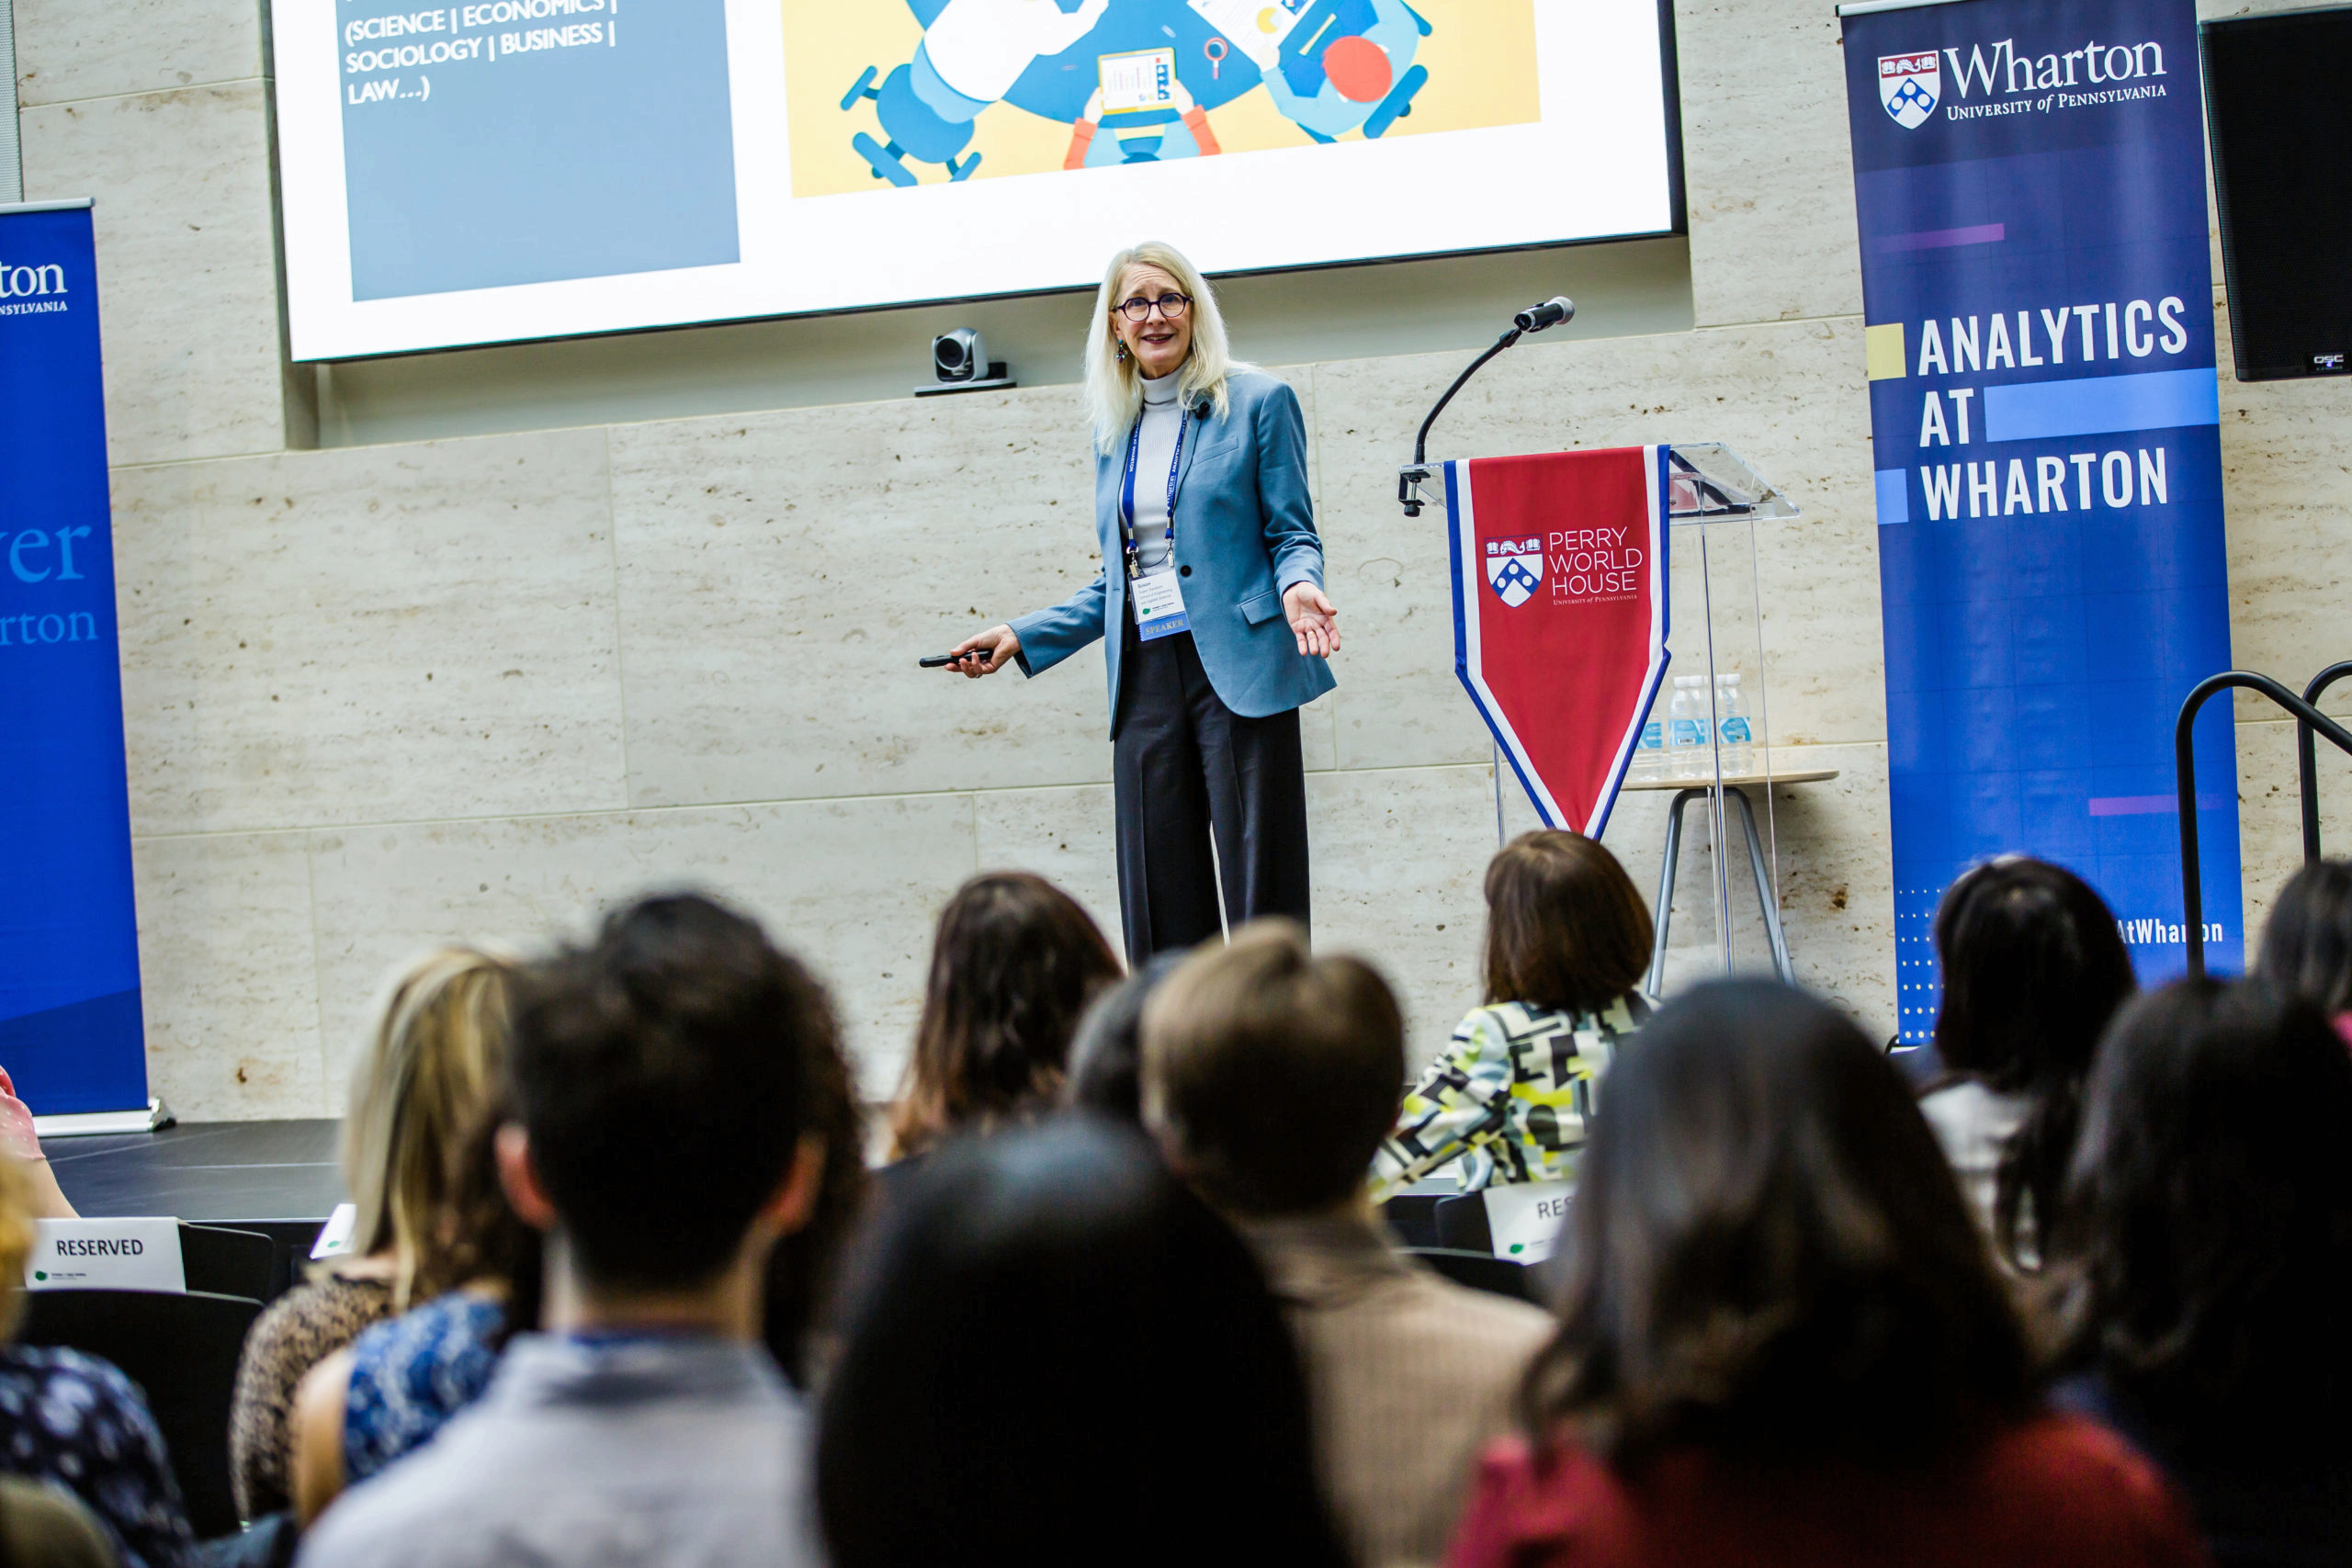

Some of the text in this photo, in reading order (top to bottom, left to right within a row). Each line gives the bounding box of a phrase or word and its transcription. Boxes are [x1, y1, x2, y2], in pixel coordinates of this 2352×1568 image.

[345, 8, 447, 47] (SCIENCE
[463, 0, 605, 28] ECONOMICS
[345, 36, 482, 73] SOCIOLOGY
[501, 22, 603, 55] BUSINESS
[1942, 38, 2167, 99] Wharton
[1946, 84, 2167, 121] UNIVERSITY of PENNSYLVANIA
[0, 260, 69, 299] ton
[1918, 296, 2188, 376] ANALYTICS
[1919, 388, 1973, 447] AT
[1920, 447, 2167, 521] WHARTON
[0, 525, 92, 583] er
[1549, 526, 1627, 552] PERRY
[1549, 548, 1643, 574] WORLD
[1552, 570, 1636, 596] HOUSE
[0, 610, 99, 646] rton
[1145, 618, 1184, 636] SPEAKER
[2117, 918, 2223, 944] AtWharon
[56, 1238, 144, 1257] RESERVED
